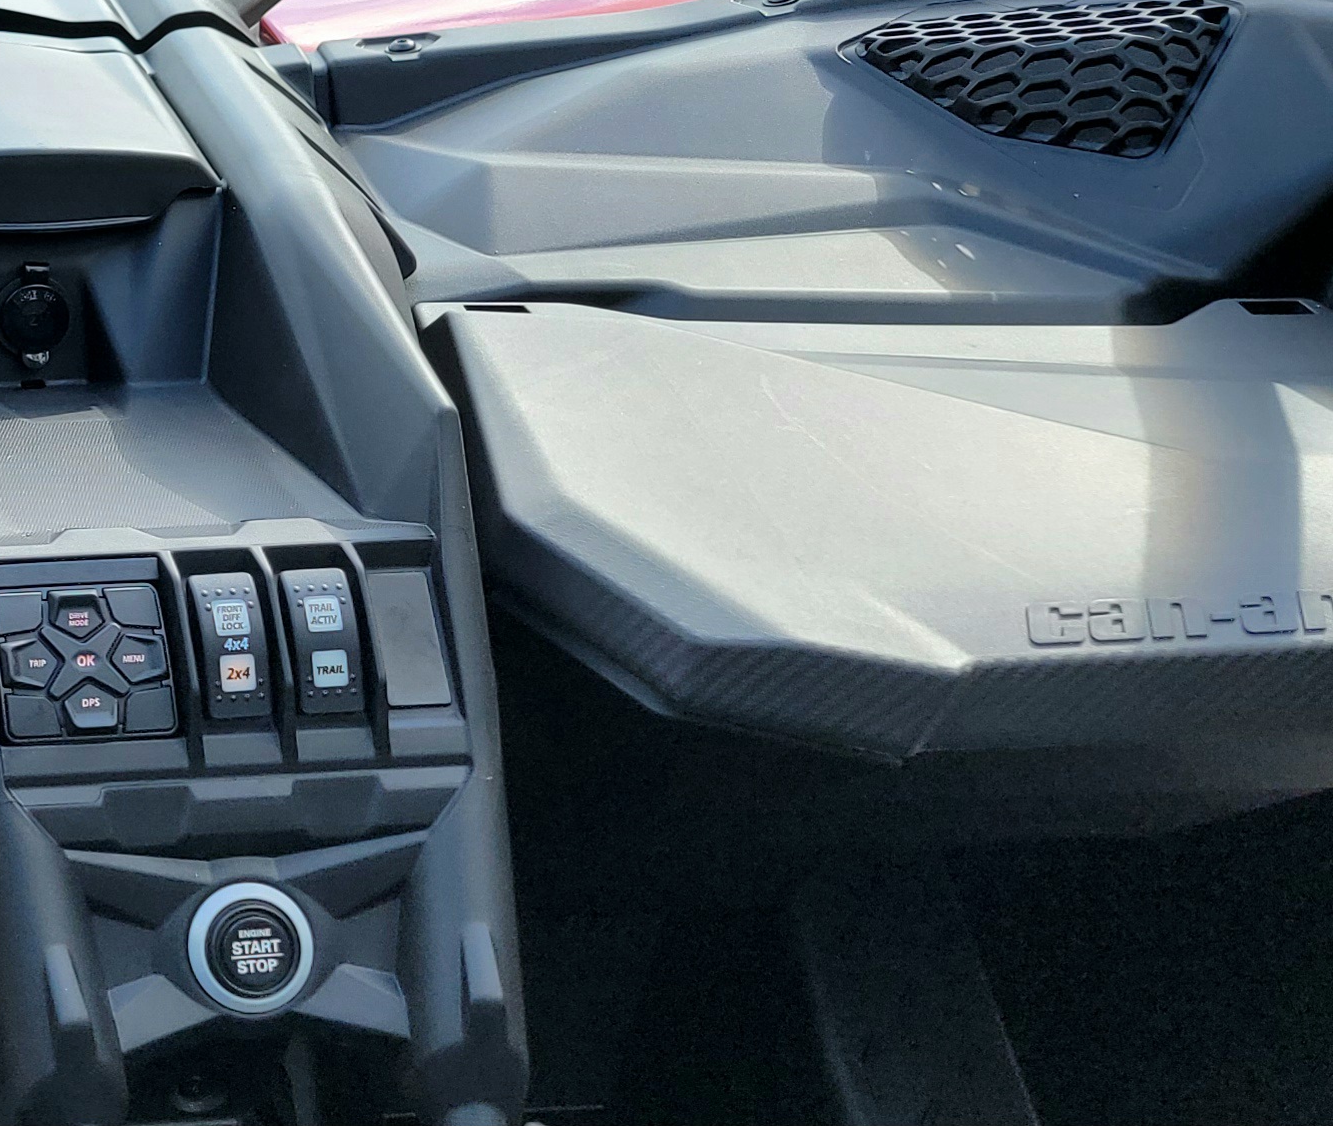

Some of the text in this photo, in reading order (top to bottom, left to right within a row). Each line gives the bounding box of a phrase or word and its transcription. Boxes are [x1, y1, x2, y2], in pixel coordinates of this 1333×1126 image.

[217, 605, 243, 613] FRONT
[309, 603, 335, 613] TRAIL
[68, 612, 89, 620] DRIVE
[222, 613, 241, 622] DIFF
[311, 615, 337, 624] ACTIV
[222, 622, 244, 630] LOCK
[224, 637, 249, 652] 4x4
[29, 659, 47, 668] TRIP
[77, 655, 96, 667] OK
[122, 654, 145, 664] MENU
[226, 667, 250, 680] 2x4
[316, 664, 345, 675] TRAIL
[82, 698, 101, 707] DPS
[238, 928, 272, 939] ENGINE
[232, 939, 282, 955] START
[237, 958, 279, 975] STOP
